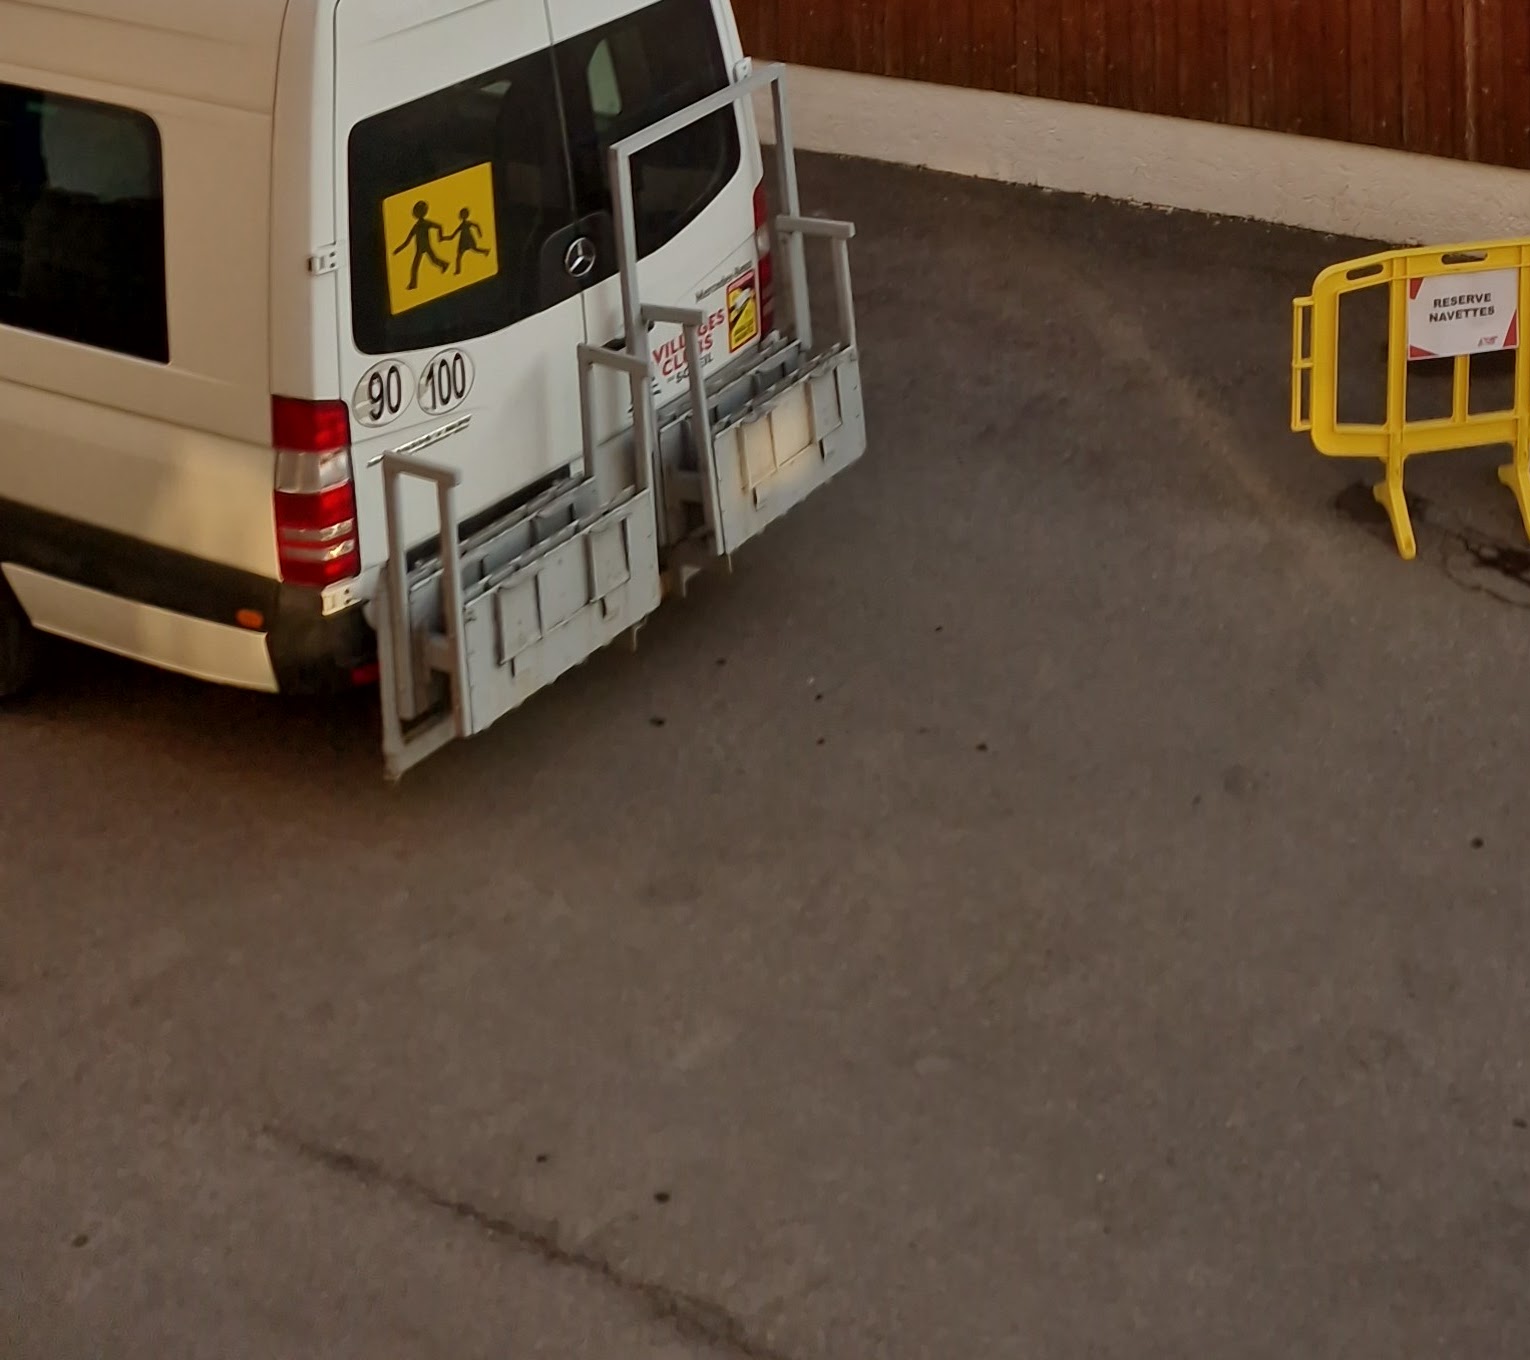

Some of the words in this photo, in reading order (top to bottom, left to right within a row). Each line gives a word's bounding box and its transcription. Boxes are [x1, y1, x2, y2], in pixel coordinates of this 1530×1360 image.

[1429, 306, 1495, 322] NAVETTES
[1433, 293, 1492, 308] RESERVE
[652, 308, 725, 365] VILLGES
[368, 365, 402, 421] 90
[425, 352, 466, 410] 100
